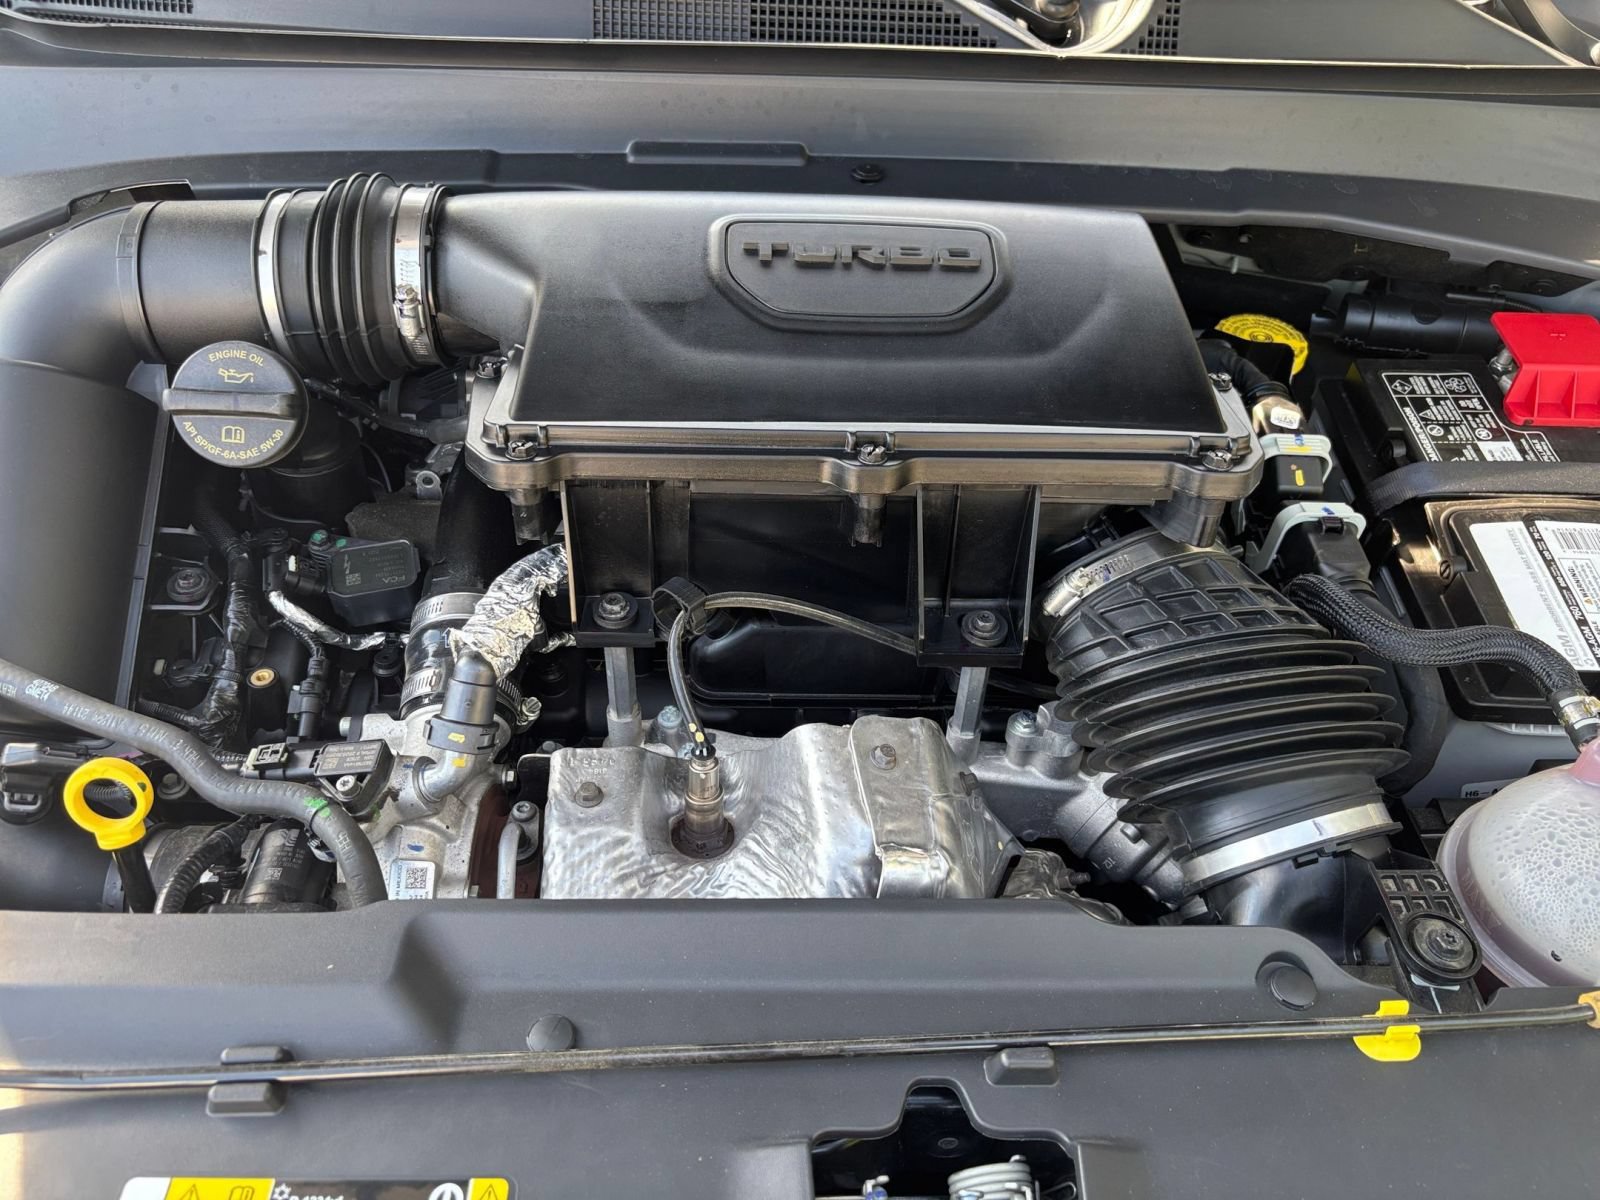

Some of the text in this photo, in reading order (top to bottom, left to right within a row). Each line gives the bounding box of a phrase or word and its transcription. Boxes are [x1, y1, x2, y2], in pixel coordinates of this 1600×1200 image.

[743, 242, 981, 267] TURBO
[208, 349, 264, 367] ENGINE OIL
[183, 421, 284, 459] API SP/GF-6A-SAE 5W-30
[382, 575, 406, 584] FCA
[1570, 605, 1585, 620] 760
